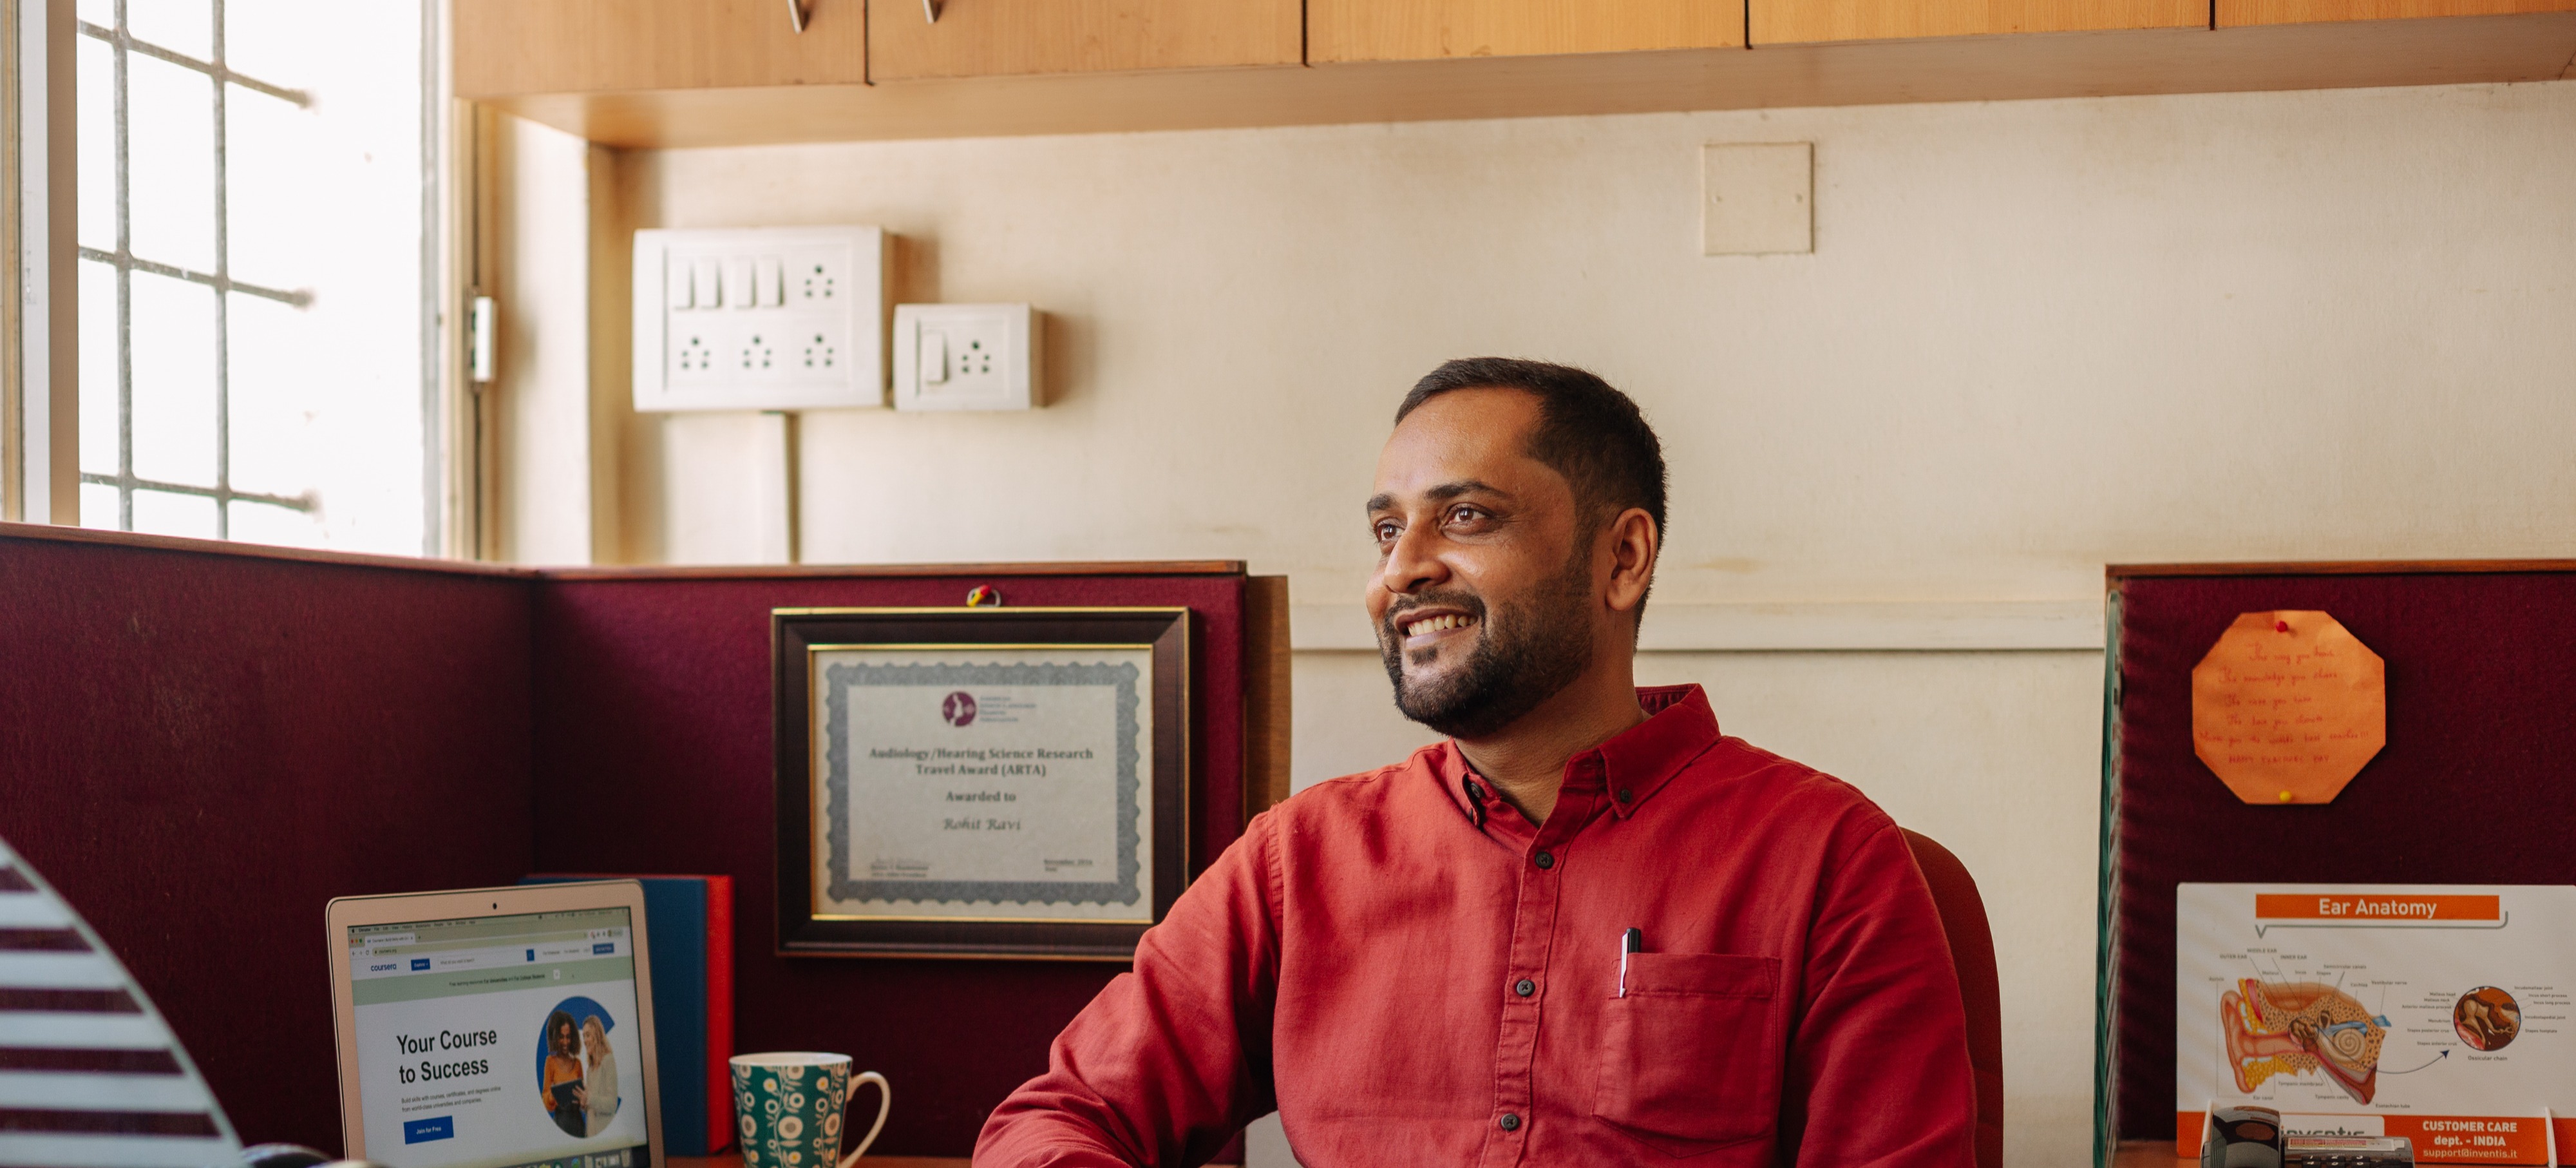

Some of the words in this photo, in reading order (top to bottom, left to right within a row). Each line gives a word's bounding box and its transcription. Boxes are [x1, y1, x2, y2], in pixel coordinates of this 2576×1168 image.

[869, 749, 985, 761] Audiology/Hearing
[989, 749, 1034, 759] Science
[1037, 748, 1094, 759] Research
[916, 764, 954, 774] Travel
[958, 764, 998, 775] Award
[1001, 764, 1046, 777] (ARTA)
[946, 791, 1000, 801] Awarded
[1004, 792, 1016, 801] to
[944, 816, 981, 830] Rohit
[986, 818, 1021, 830] Ravi
[2319, 897, 2351, 915] Ear
[2355, 897, 2438, 919] Anatomy
[371, 963, 397, 972] coursera
[396, 1034, 435, 1055] Your
[440, 1029, 497, 1050] Course
[399, 1065, 416, 1084] to
[421, 1059, 489, 1081] Success
[2423, 1120, 2485, 1132] CUSTOMER
[2487, 1122, 2517, 1133] CARE
[2434, 1135, 2463, 1147] dept.
[2474, 1136, 2506, 1146] INDIA
[2423, 1148, 2517, 1158] support@inventis.it
